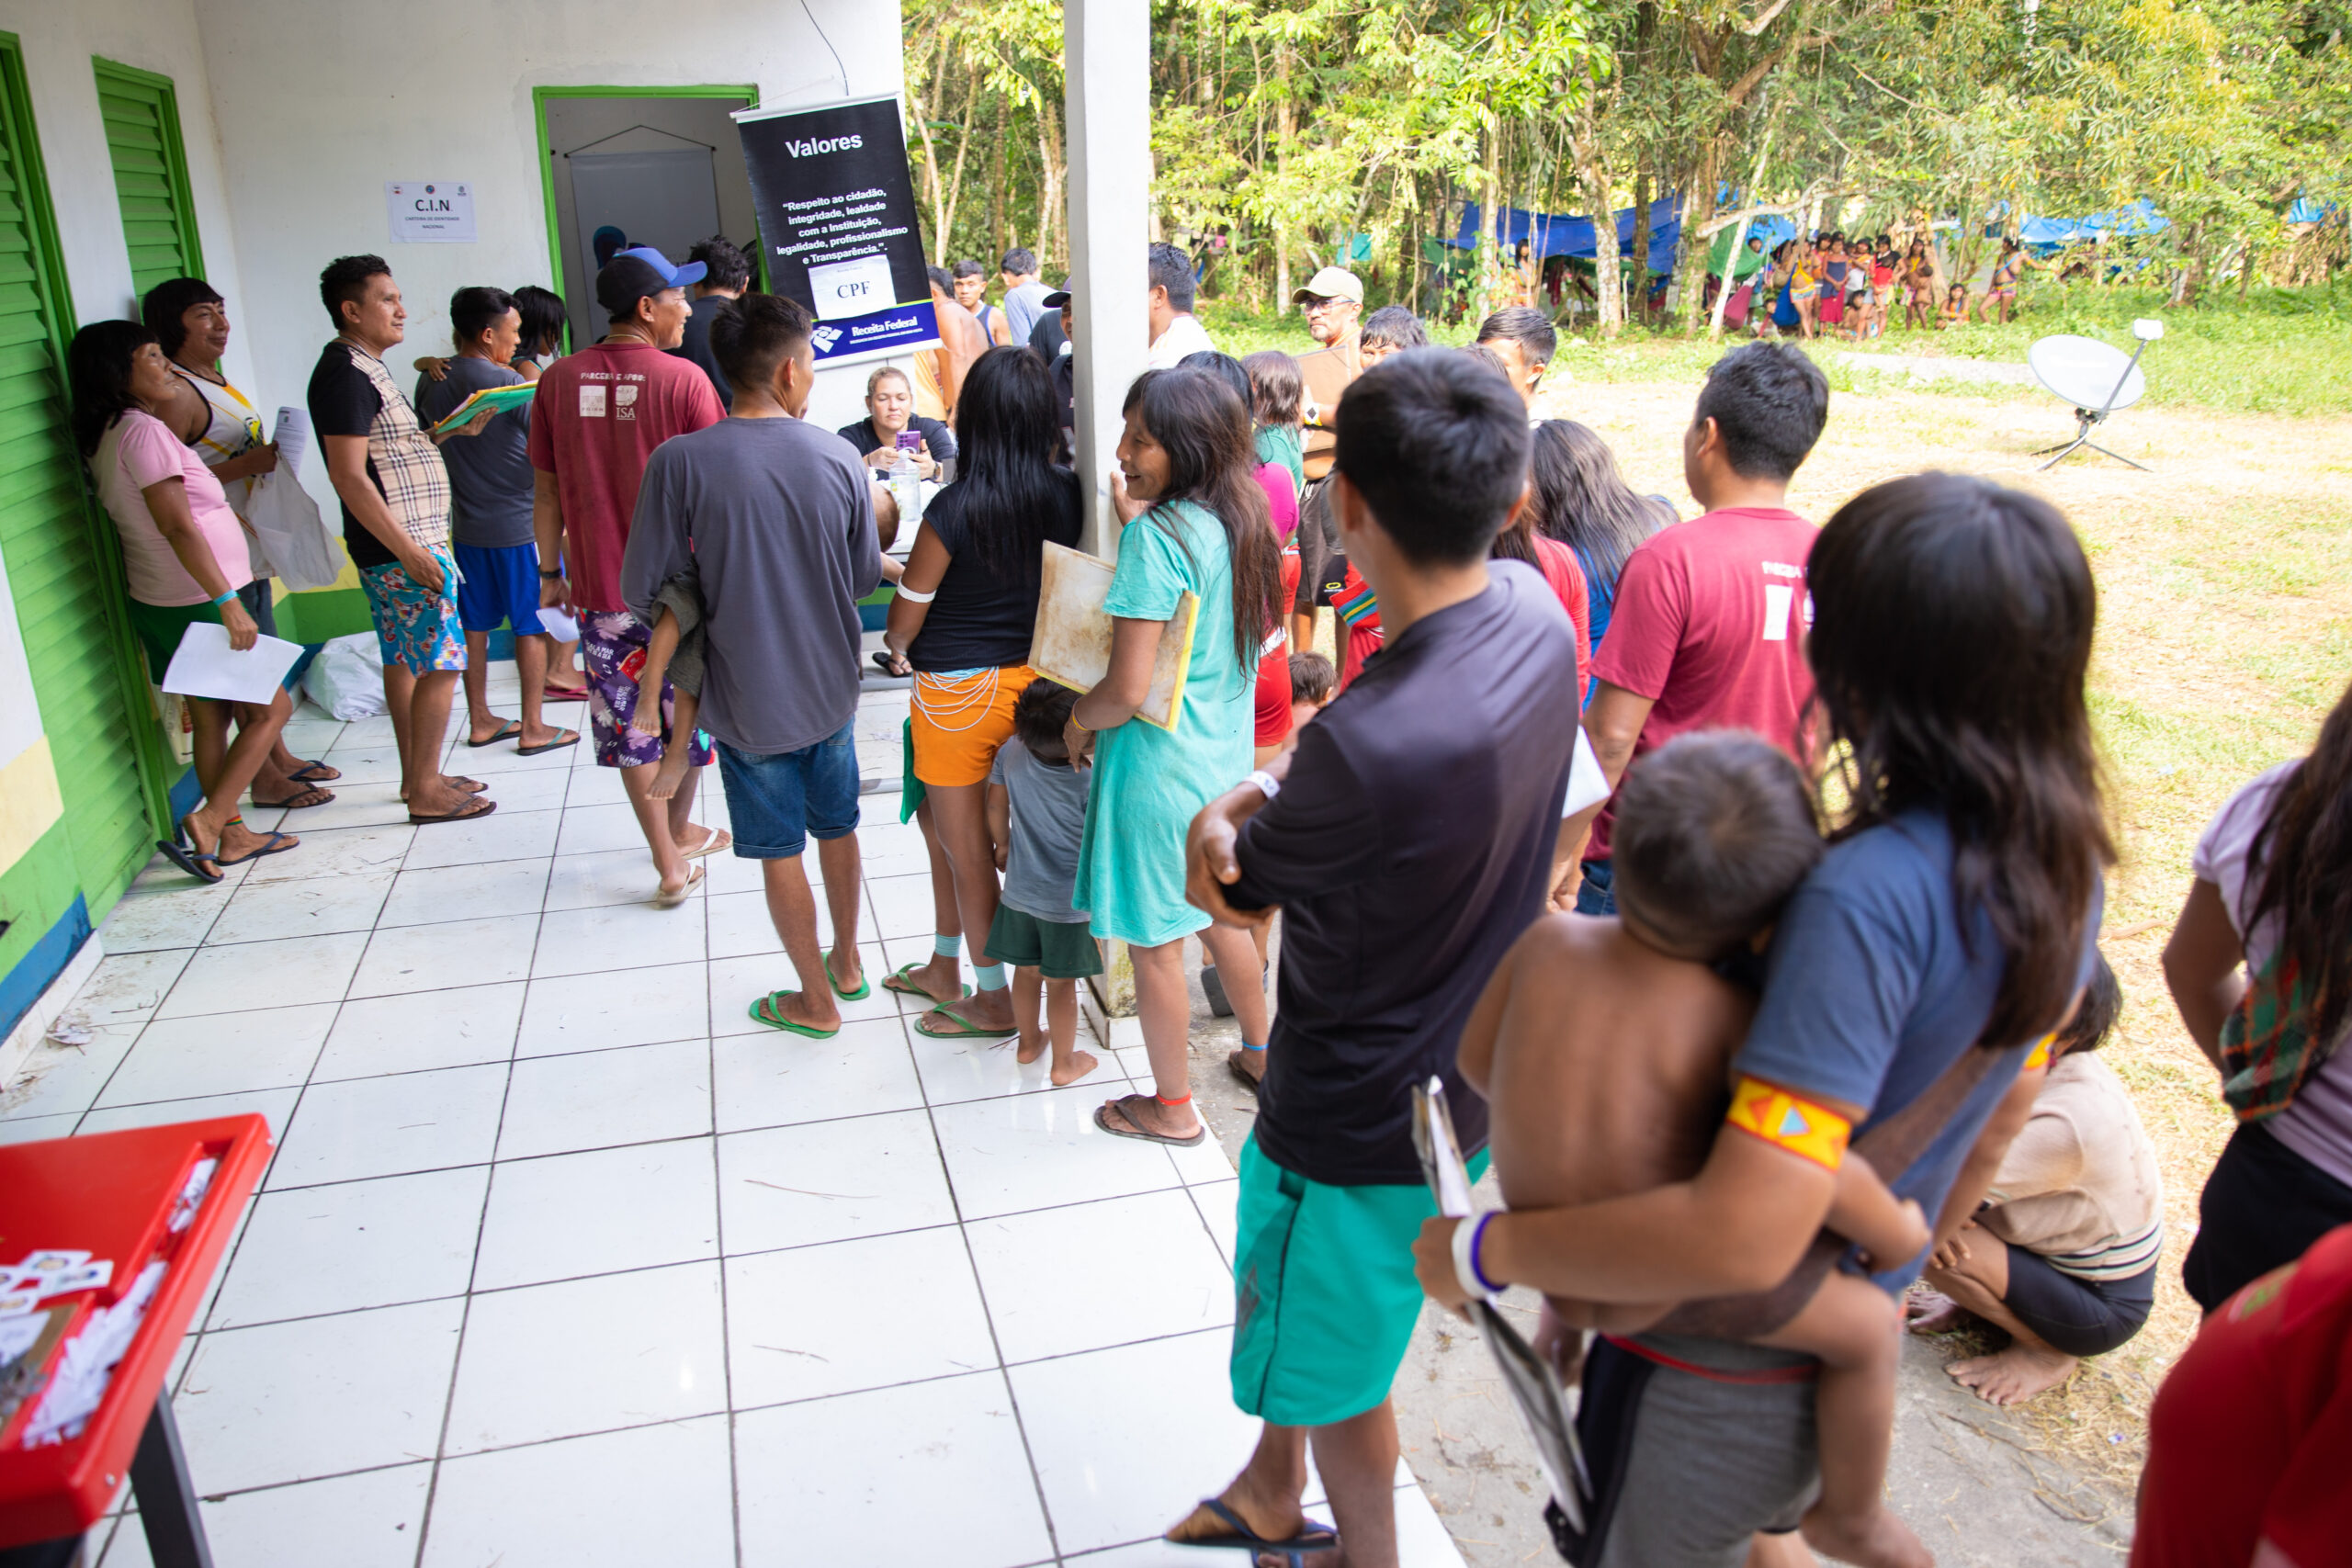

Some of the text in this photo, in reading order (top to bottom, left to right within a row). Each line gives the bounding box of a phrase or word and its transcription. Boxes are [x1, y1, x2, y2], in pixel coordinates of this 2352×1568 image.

[785, 133, 864, 159] Valores
[831, 196, 844, 204] ao
[845, 187, 887, 202] cidadão,
[787, 201, 887, 225] integridade, lealdade
[798, 216, 882, 238] com a Instituição,
[776, 226, 909, 256] legalidade, profissionalismo
[802, 256, 809, 265] e
[837, 280, 870, 299] CPF
[851, 322, 885, 337] Receita
[884, 316, 919, 331] Federal
[616, 407, 636, 419] ISA
